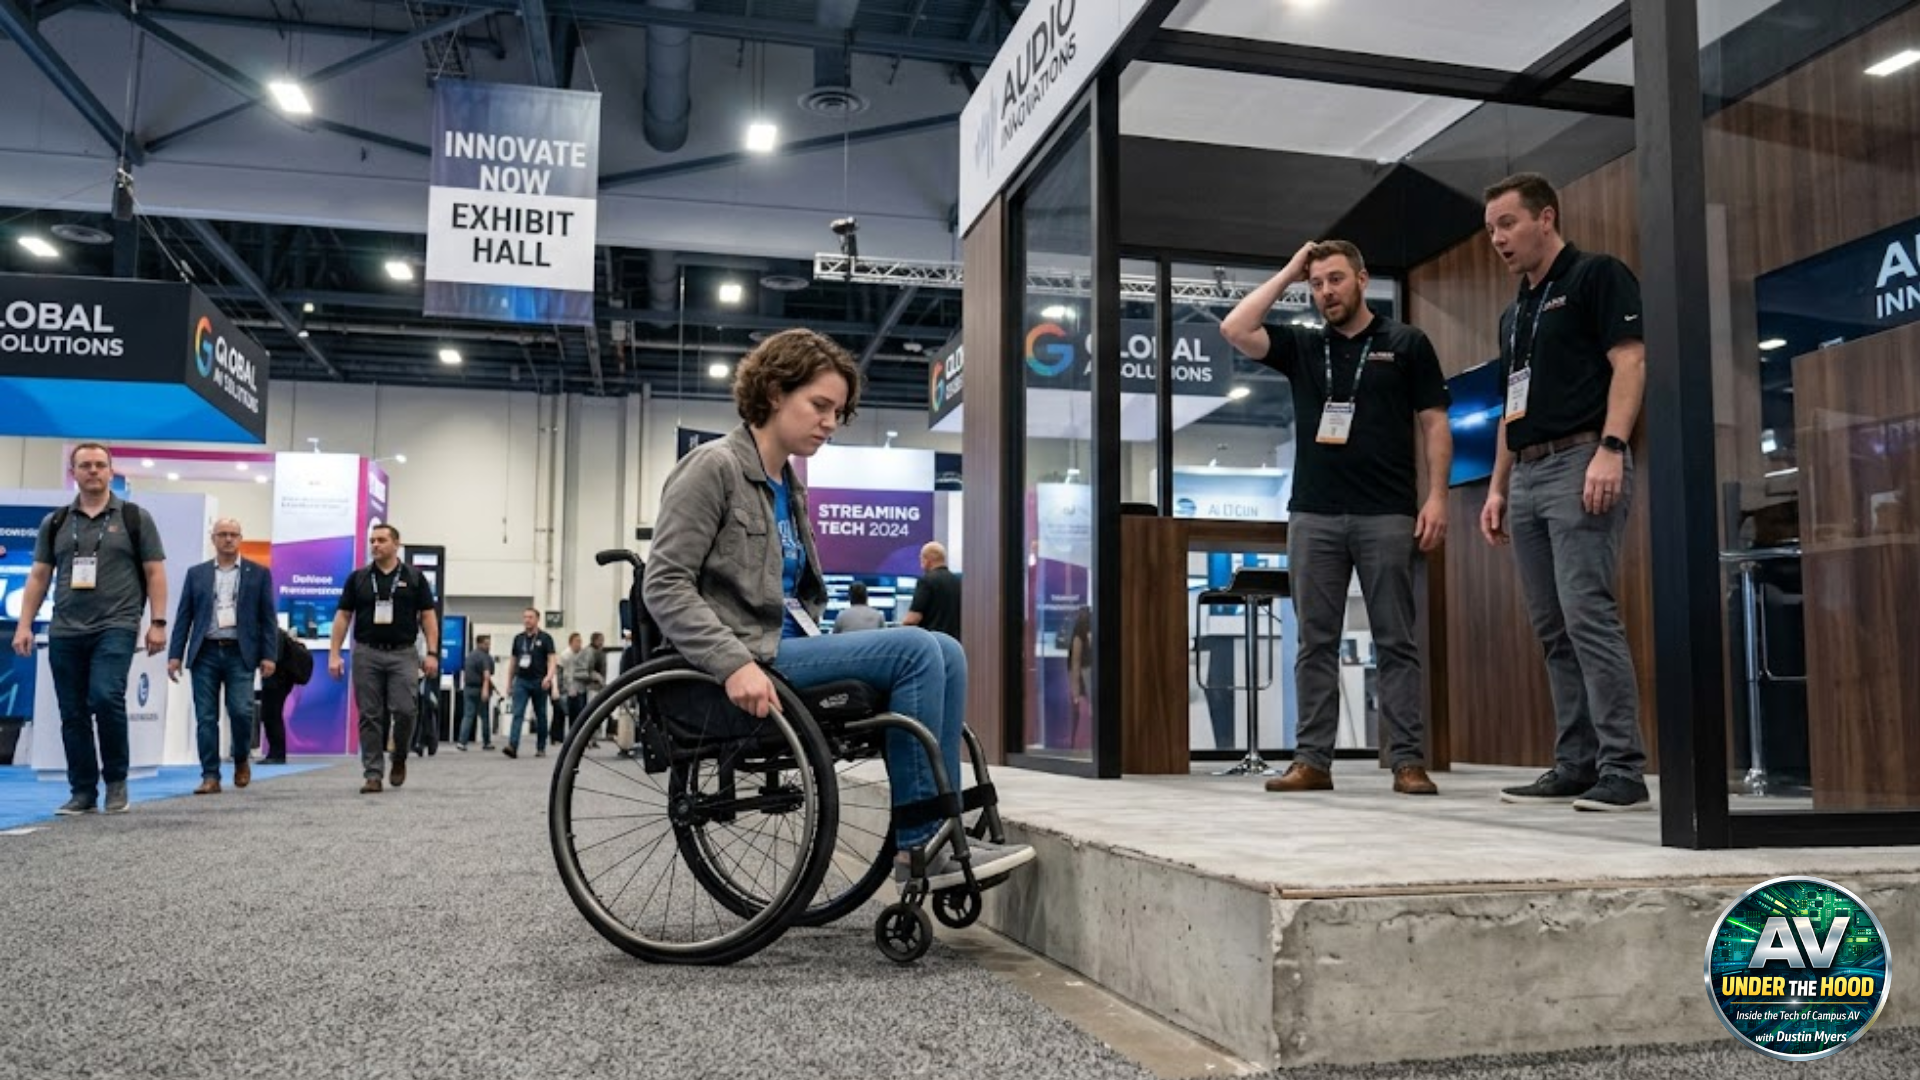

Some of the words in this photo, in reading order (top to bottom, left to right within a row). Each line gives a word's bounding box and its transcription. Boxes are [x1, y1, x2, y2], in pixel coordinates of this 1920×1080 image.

[1001, 0, 1076, 120] AUDIO
[445, 130, 587, 168] INNOVATE
[479, 165, 551, 196] NOW
[452, 202, 575, 237] EXHIBIT
[472, 236, 552, 268] HALL
[817, 520, 866, 536] TECH
[868, 522, 910, 537] 2024
[818, 503, 921, 522] STREAMING
